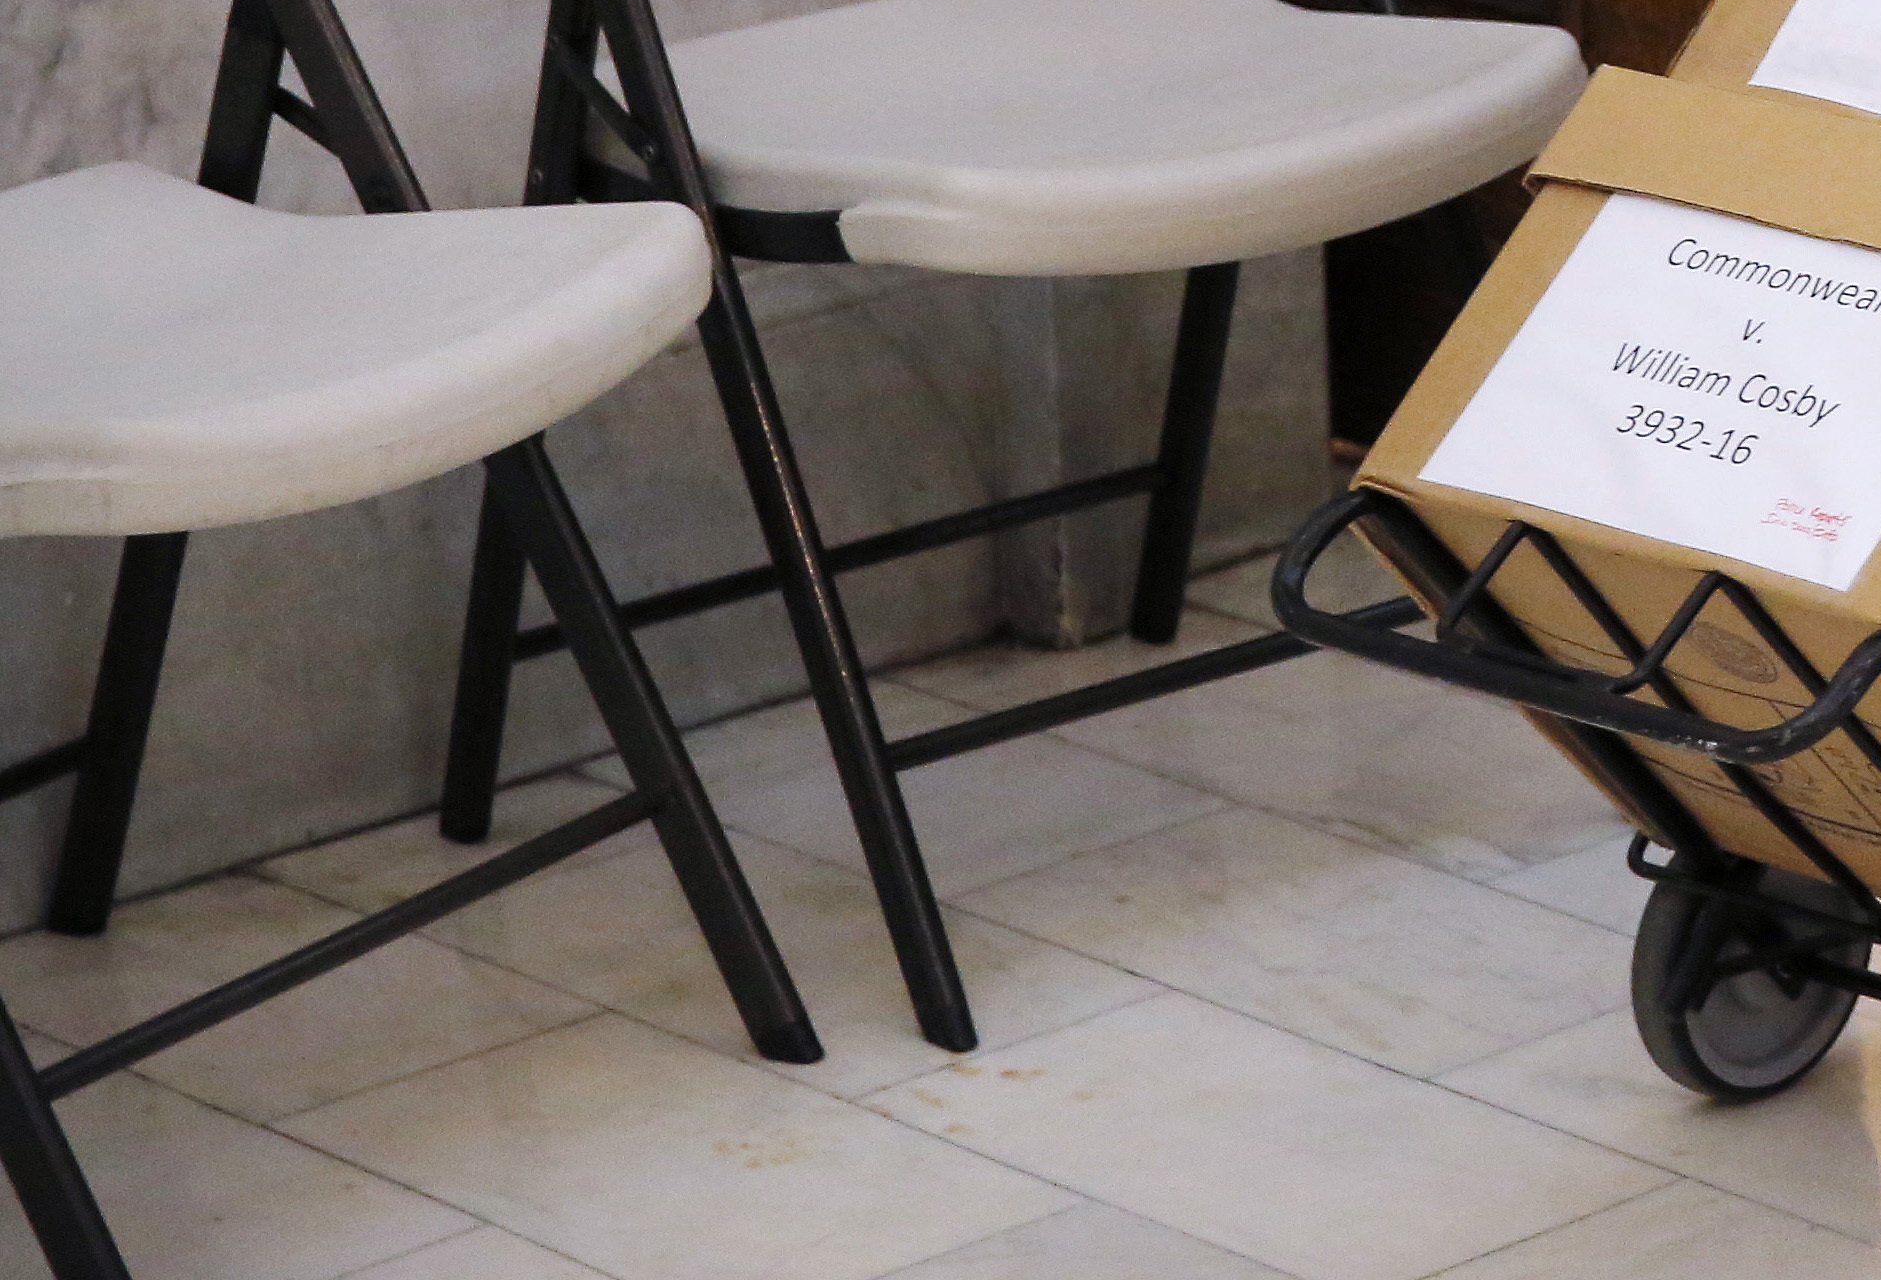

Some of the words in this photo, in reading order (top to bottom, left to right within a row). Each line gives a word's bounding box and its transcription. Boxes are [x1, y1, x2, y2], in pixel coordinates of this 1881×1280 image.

[1742, 317, 1762, 344] v.
[1612, 342, 1731, 397] William
[1739, 373, 1839, 428] Cosby
[1617, 404, 1758, 466] 3932-16
